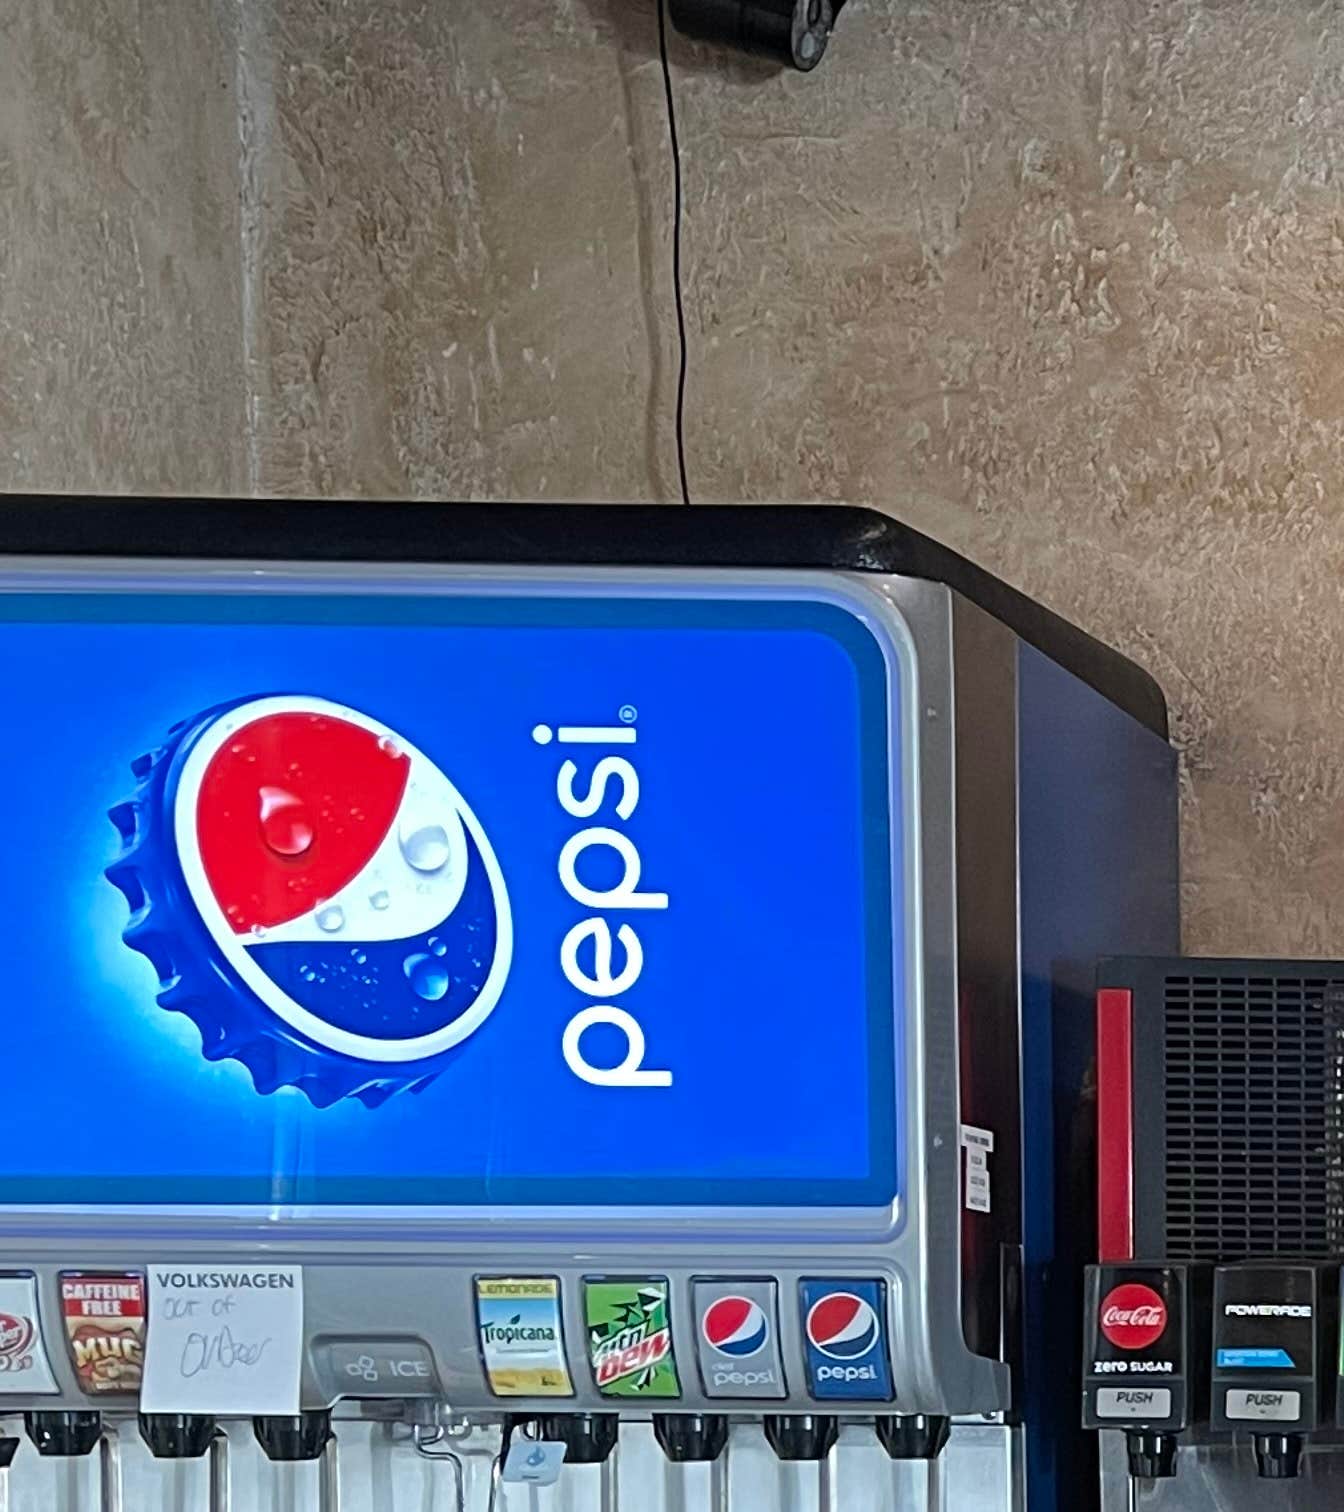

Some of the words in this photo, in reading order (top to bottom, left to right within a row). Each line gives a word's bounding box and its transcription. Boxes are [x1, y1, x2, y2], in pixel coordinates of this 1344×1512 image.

[531, 726, 673, 1087] pepsi
[157, 1273, 294, 1289] VOLKSWAGEN
[479, 1283, 553, 1295] LEMONADE
[62, 1283, 141, 1300] CAFFEINE
[82, 1300, 123, 1316] FREE
[1103, 1305, 1163, 1327] Coca-Cola
[1225, 1304, 1312, 1318] POWERADE
[480, 1321, 555, 1344] Tropicana
[72, 1335, 144, 1369] MUG
[390, 1360, 431, 1377] ICE
[816, 1363, 878, 1382] pepsi
[1130, 1361, 1173, 1373] SUGAR
[713, 1371, 777, 1387] pepsi
[1116, 1391, 1153, 1404] PUSH
[1245, 1394, 1283, 1407] PUSH
